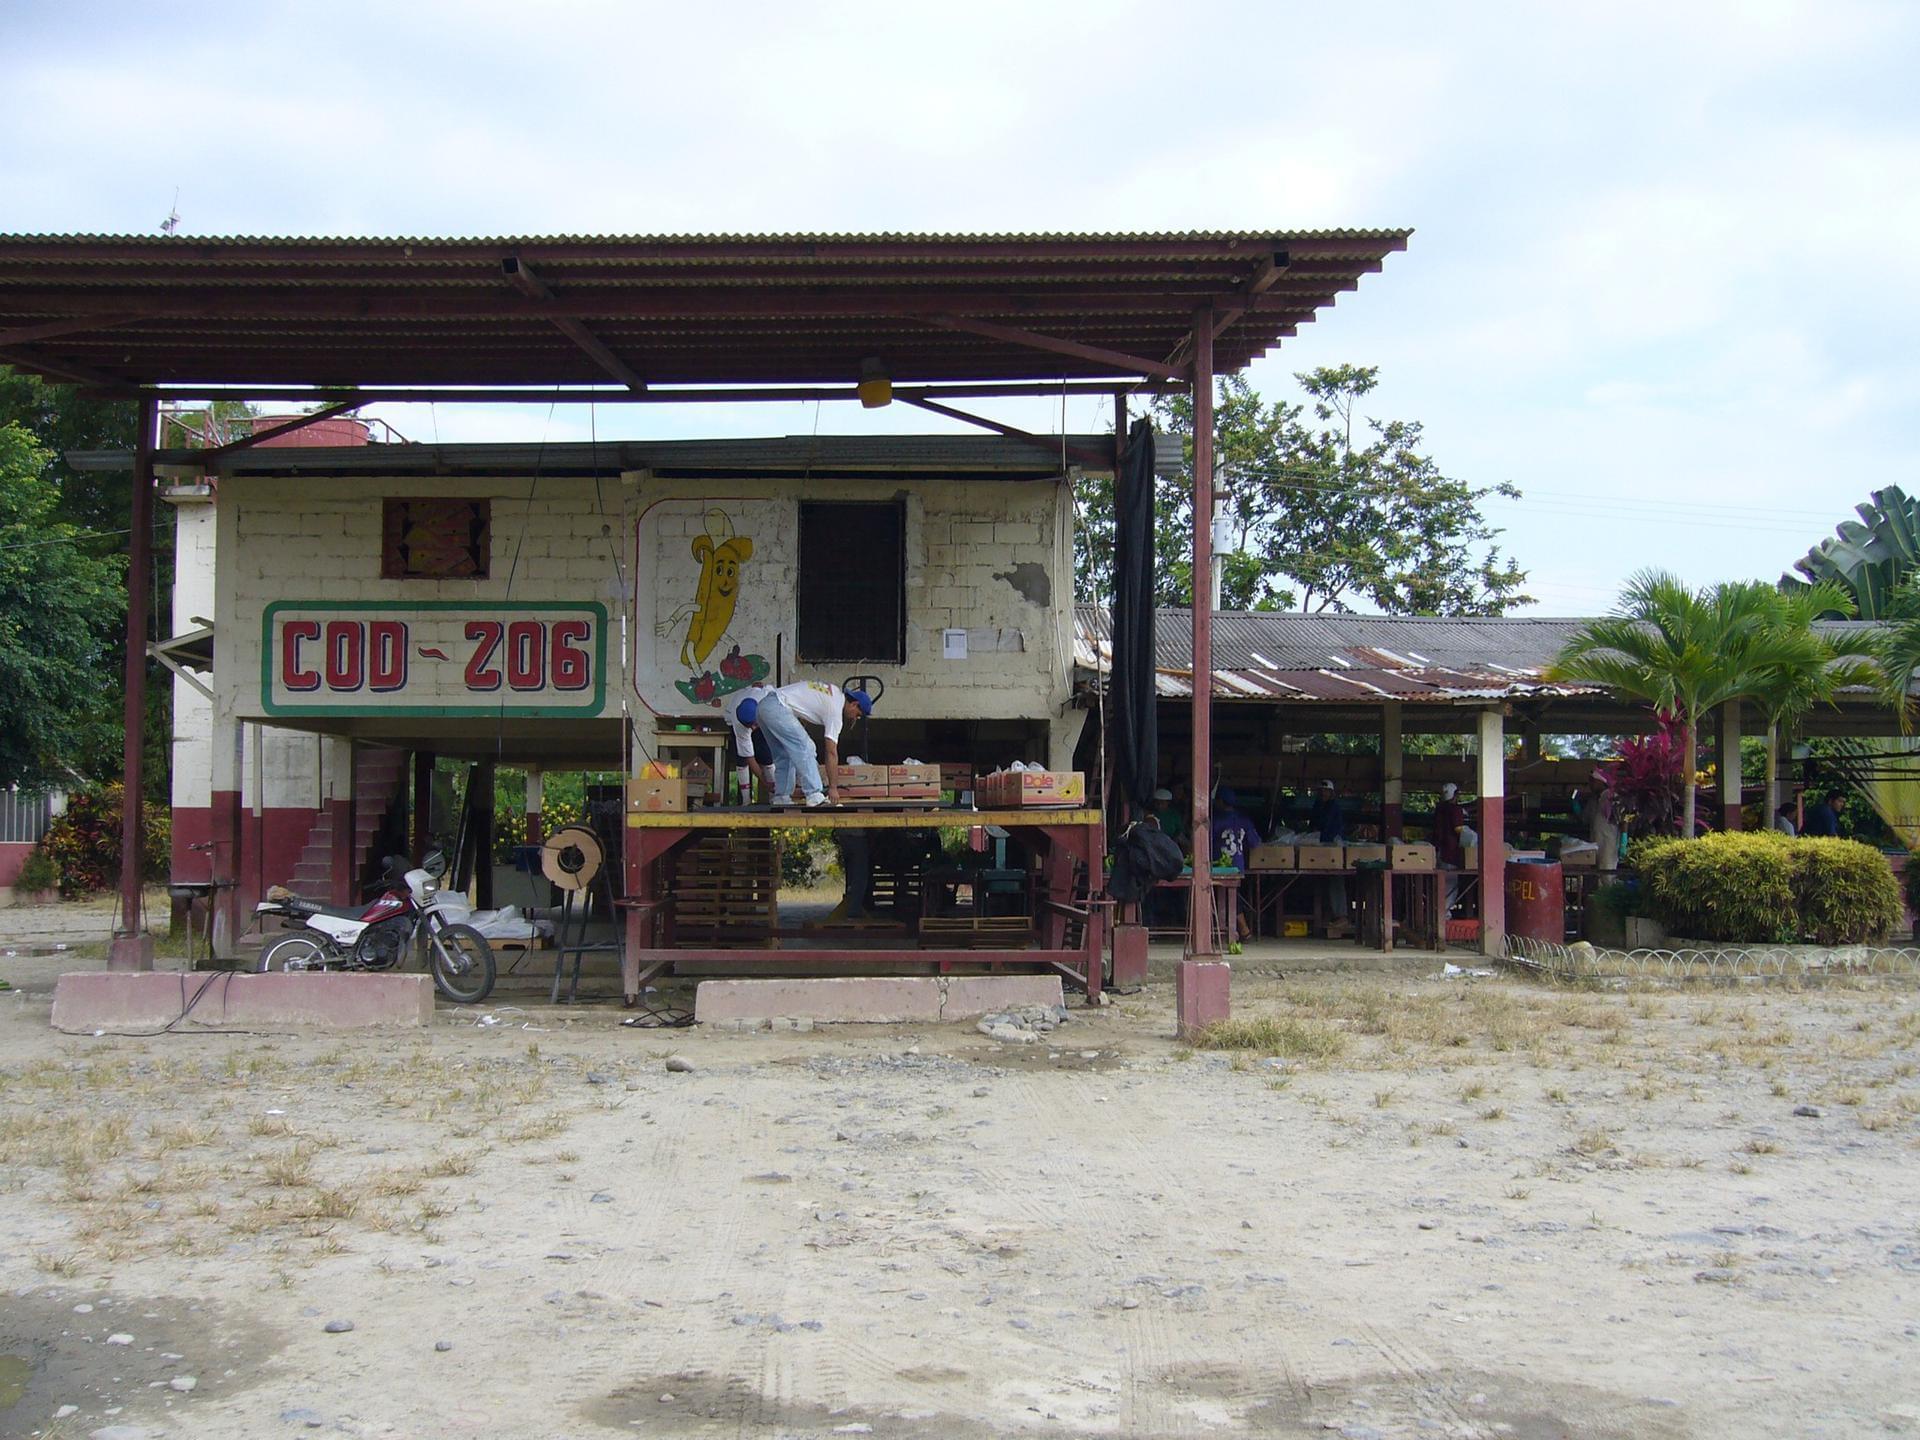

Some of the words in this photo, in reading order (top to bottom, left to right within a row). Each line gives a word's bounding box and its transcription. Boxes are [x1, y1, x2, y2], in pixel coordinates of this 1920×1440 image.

[282, 620, 408, 692] COD
[464, 620, 591, 692] 206
[1023, 773, 1054, 788] Dole
